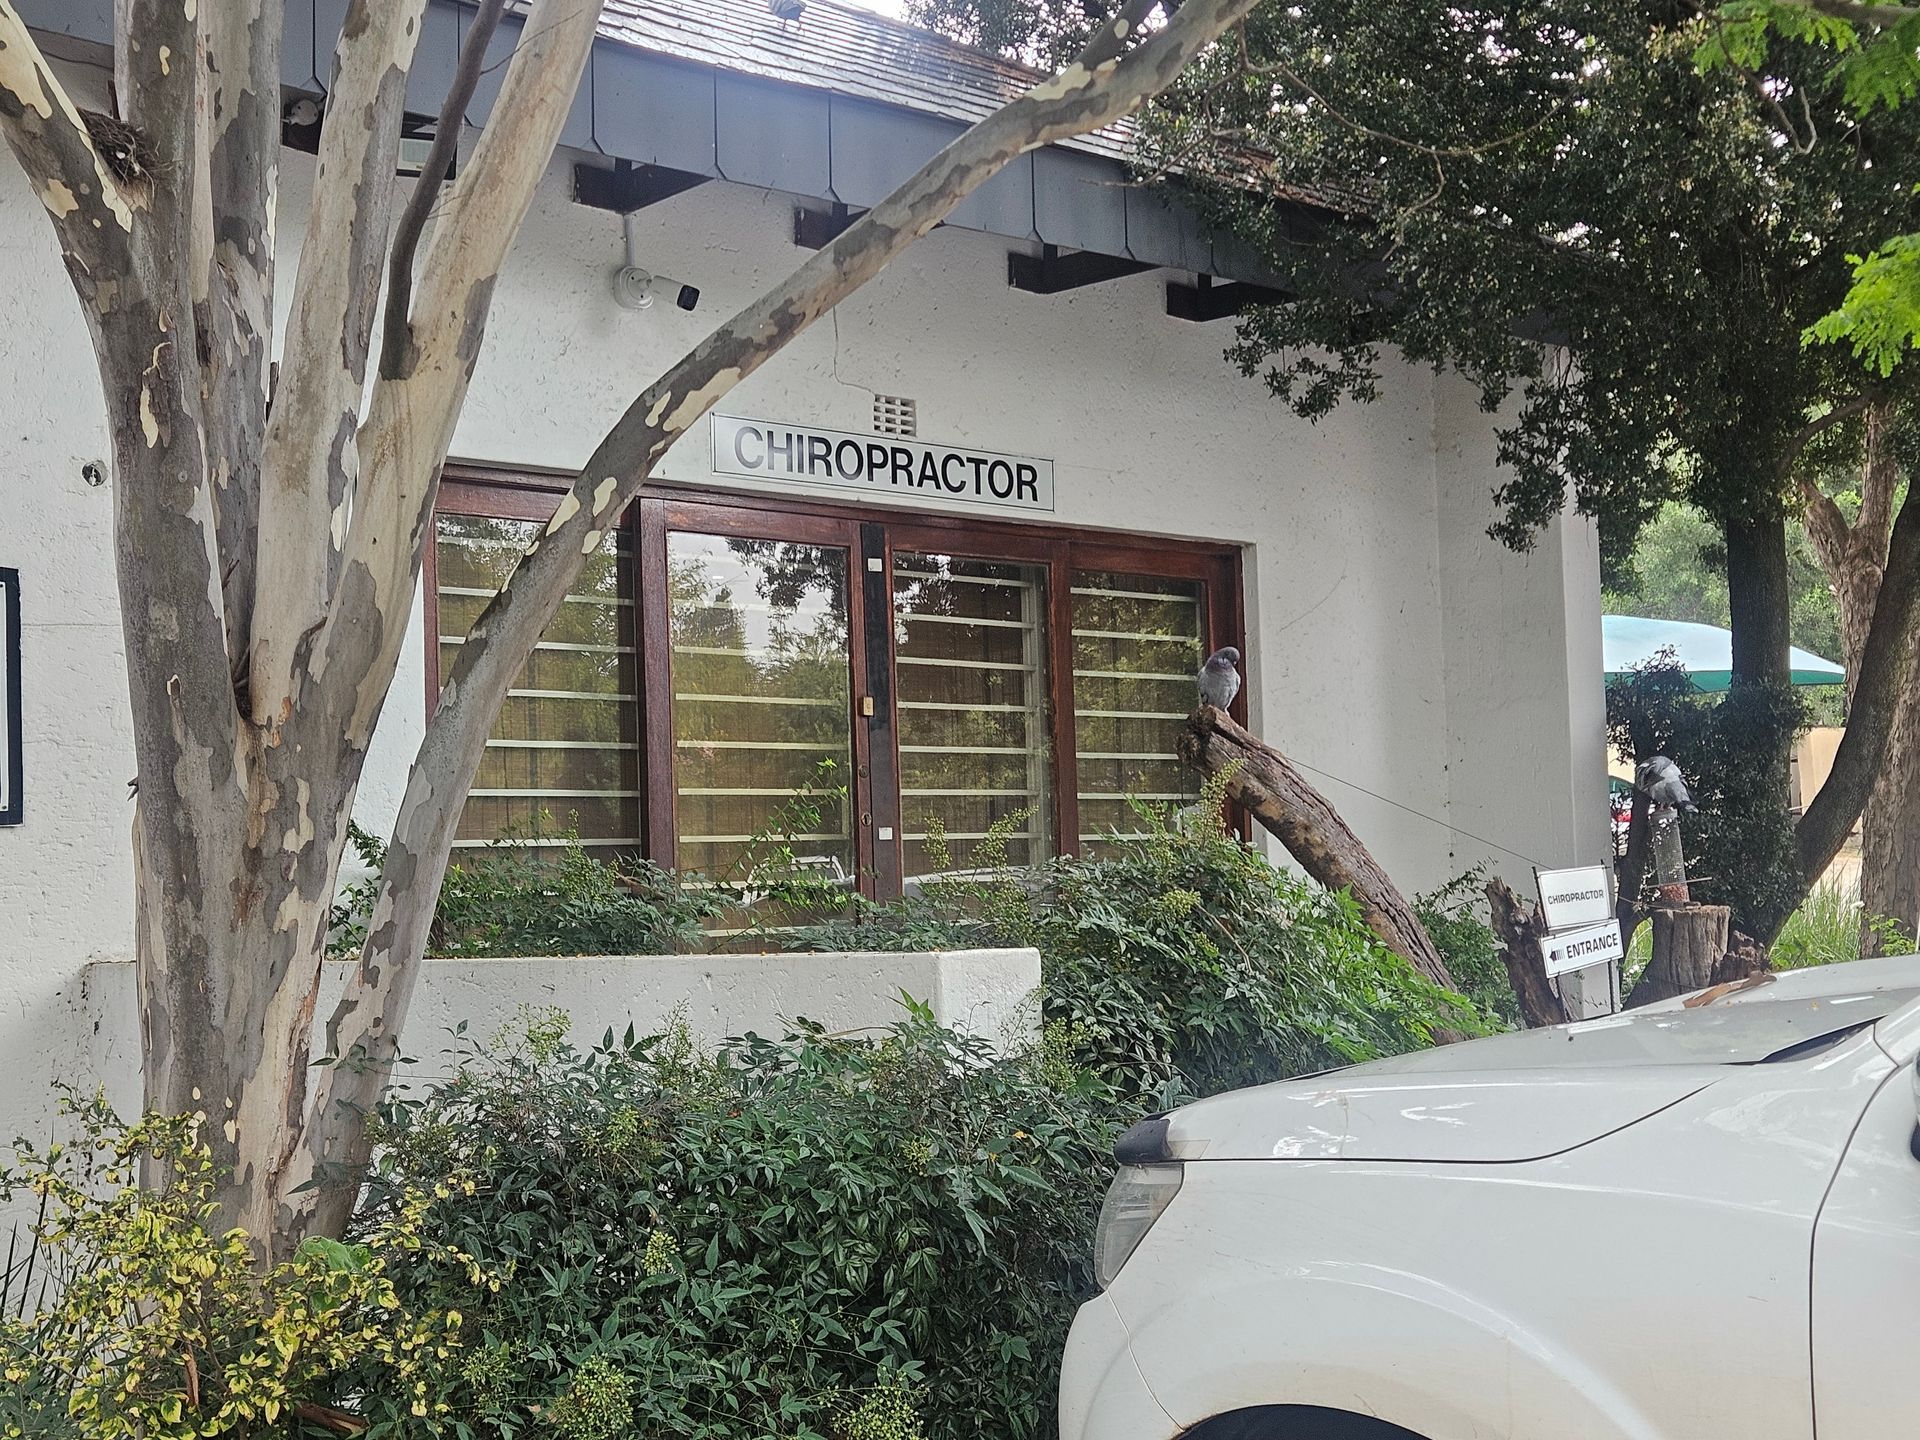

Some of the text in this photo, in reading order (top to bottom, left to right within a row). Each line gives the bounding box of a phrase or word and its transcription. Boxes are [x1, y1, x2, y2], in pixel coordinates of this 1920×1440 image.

[734, 426, 1039, 502] CHIROPRACTOR
[1547, 889, 1604, 905] CHIROPRACTOR
[1566, 933, 1618, 959] ENTRANCE
